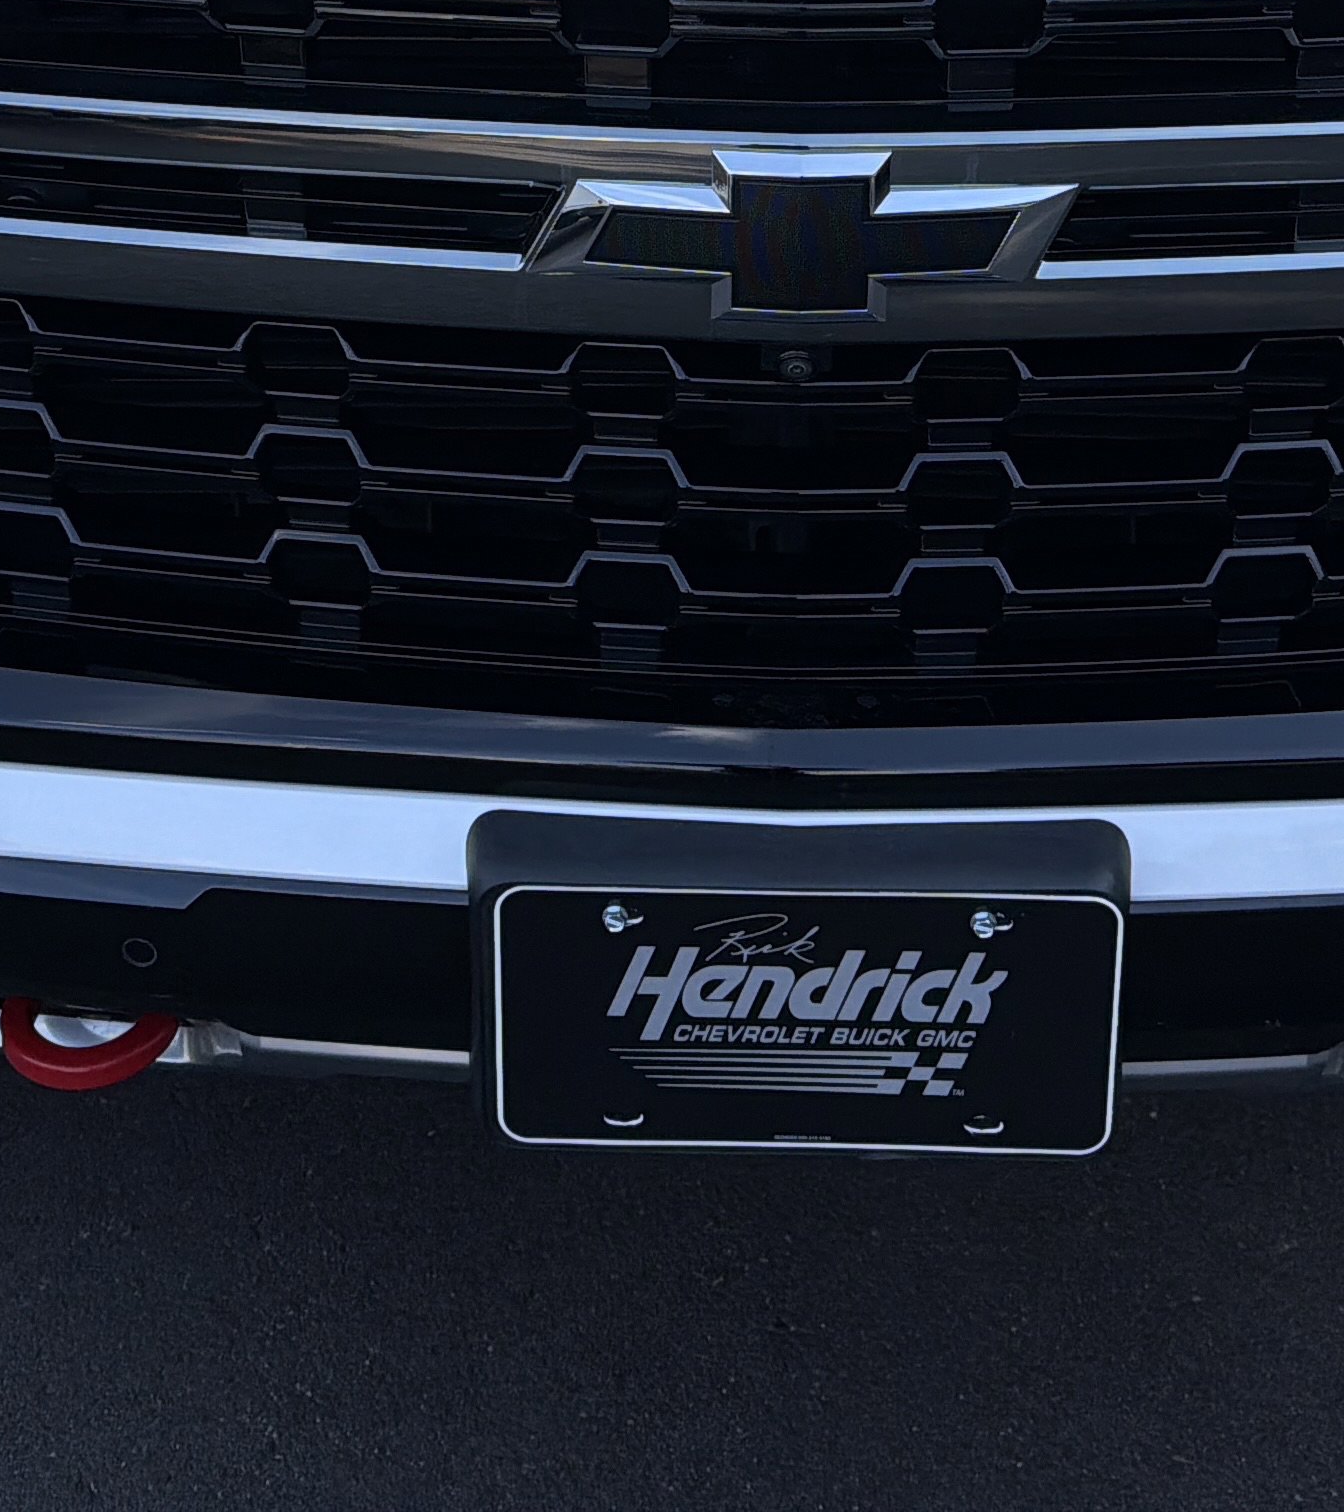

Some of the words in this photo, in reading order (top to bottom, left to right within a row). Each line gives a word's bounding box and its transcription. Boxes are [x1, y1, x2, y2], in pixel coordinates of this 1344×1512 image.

[694, 913, 820, 964] Rick
[606, 945, 1009, 1041] Hendrick
[673, 1024, 825, 1047] CHEVROLET
[829, 1028, 911, 1048] BUICK
[916, 1029, 977, 1049] GMC
[953, 1088, 965, 1097] TM
